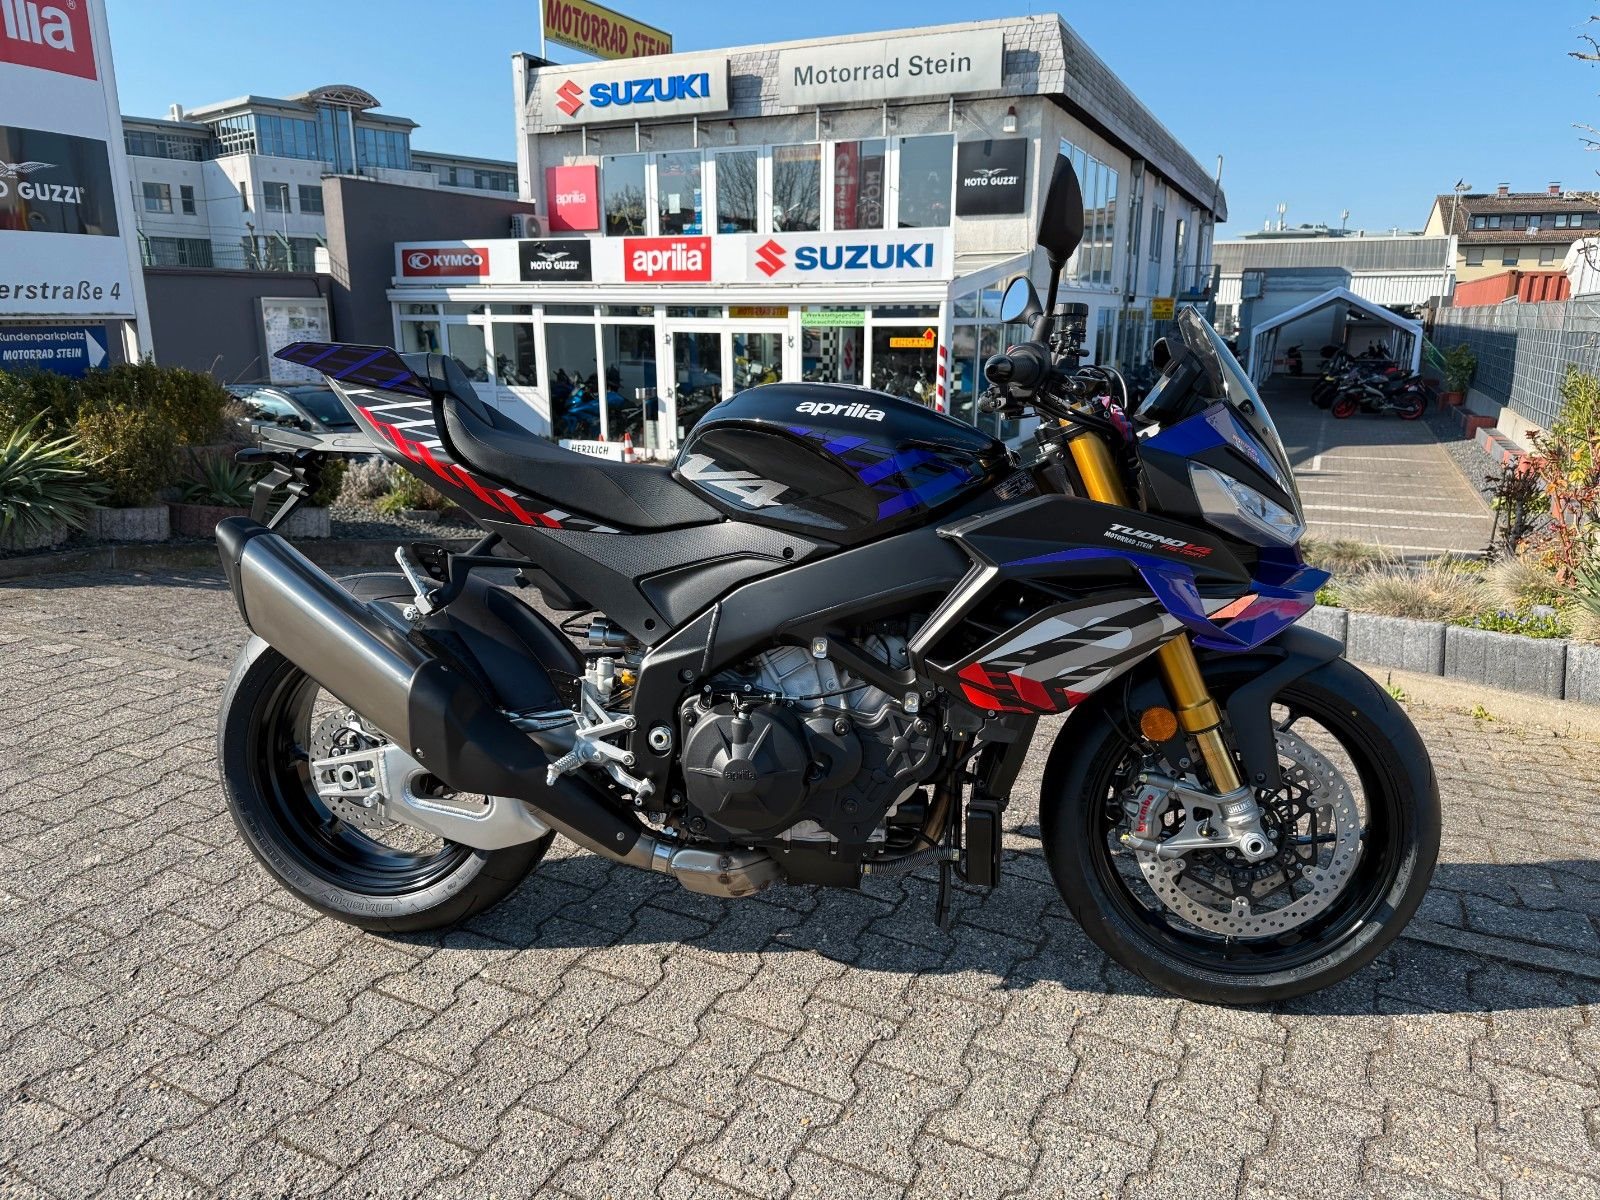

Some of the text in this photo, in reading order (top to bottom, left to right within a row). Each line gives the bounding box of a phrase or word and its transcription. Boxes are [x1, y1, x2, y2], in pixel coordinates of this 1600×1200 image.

[546, 0, 629, 55] MOTORRAD
[794, 52, 971, 86] Motorrad Stein
[590, 72, 710, 107] SUZUKI
[964, 176, 1017, 187] MOTO GUZZI
[18, 181, 82, 204] GUZZI
[556, 190, 587, 206] aprilia
[433, 254, 484, 267] KYMCO
[530, 259, 578, 271] MOTO GUZZI
[632, 243, 703, 276] aprilia
[795, 243, 934, 270] SUZUKI
[0, 280, 121, 300] erstraße 4
[3, 348, 82, 360] MOTORRAD STEIN
[796, 401, 885, 421] aprilia
[571, 443, 609, 455] HERZLICH
[1104, 530, 1154, 550] MOTORRAD STEIN
[1110, 523, 1187, 547] TUONO
[725, 770, 756, 781] aprilia
[1136, 794, 1154, 833] brembo
